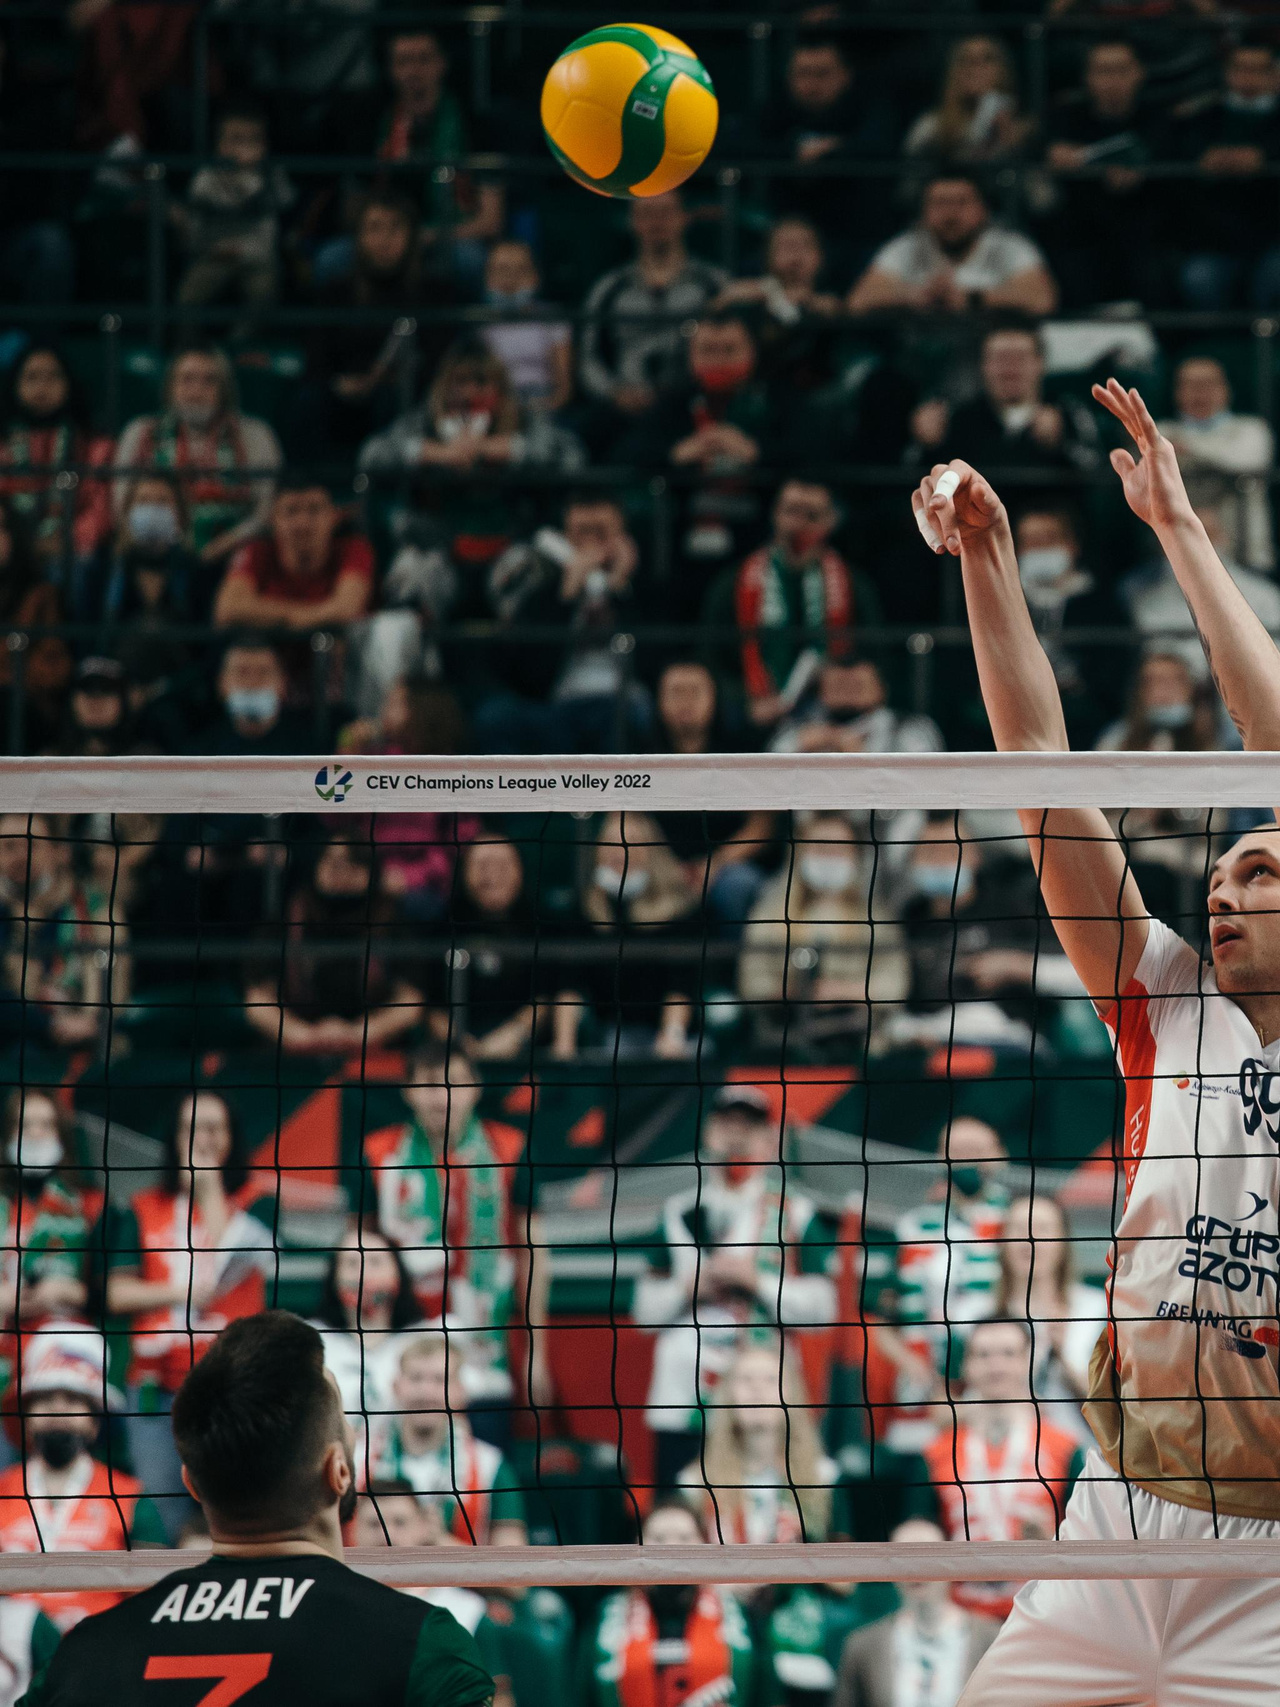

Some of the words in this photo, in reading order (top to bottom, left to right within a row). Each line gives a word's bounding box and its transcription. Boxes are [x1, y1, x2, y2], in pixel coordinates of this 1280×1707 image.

[366, 775, 400, 790] CEV
[404, 774, 494, 792] Champions
[498, 775, 557, 793] League
[560, 773, 610, 792] Volley
[613, 773, 651, 789] 2022
[151, 1577, 316, 1624] ABAEV
